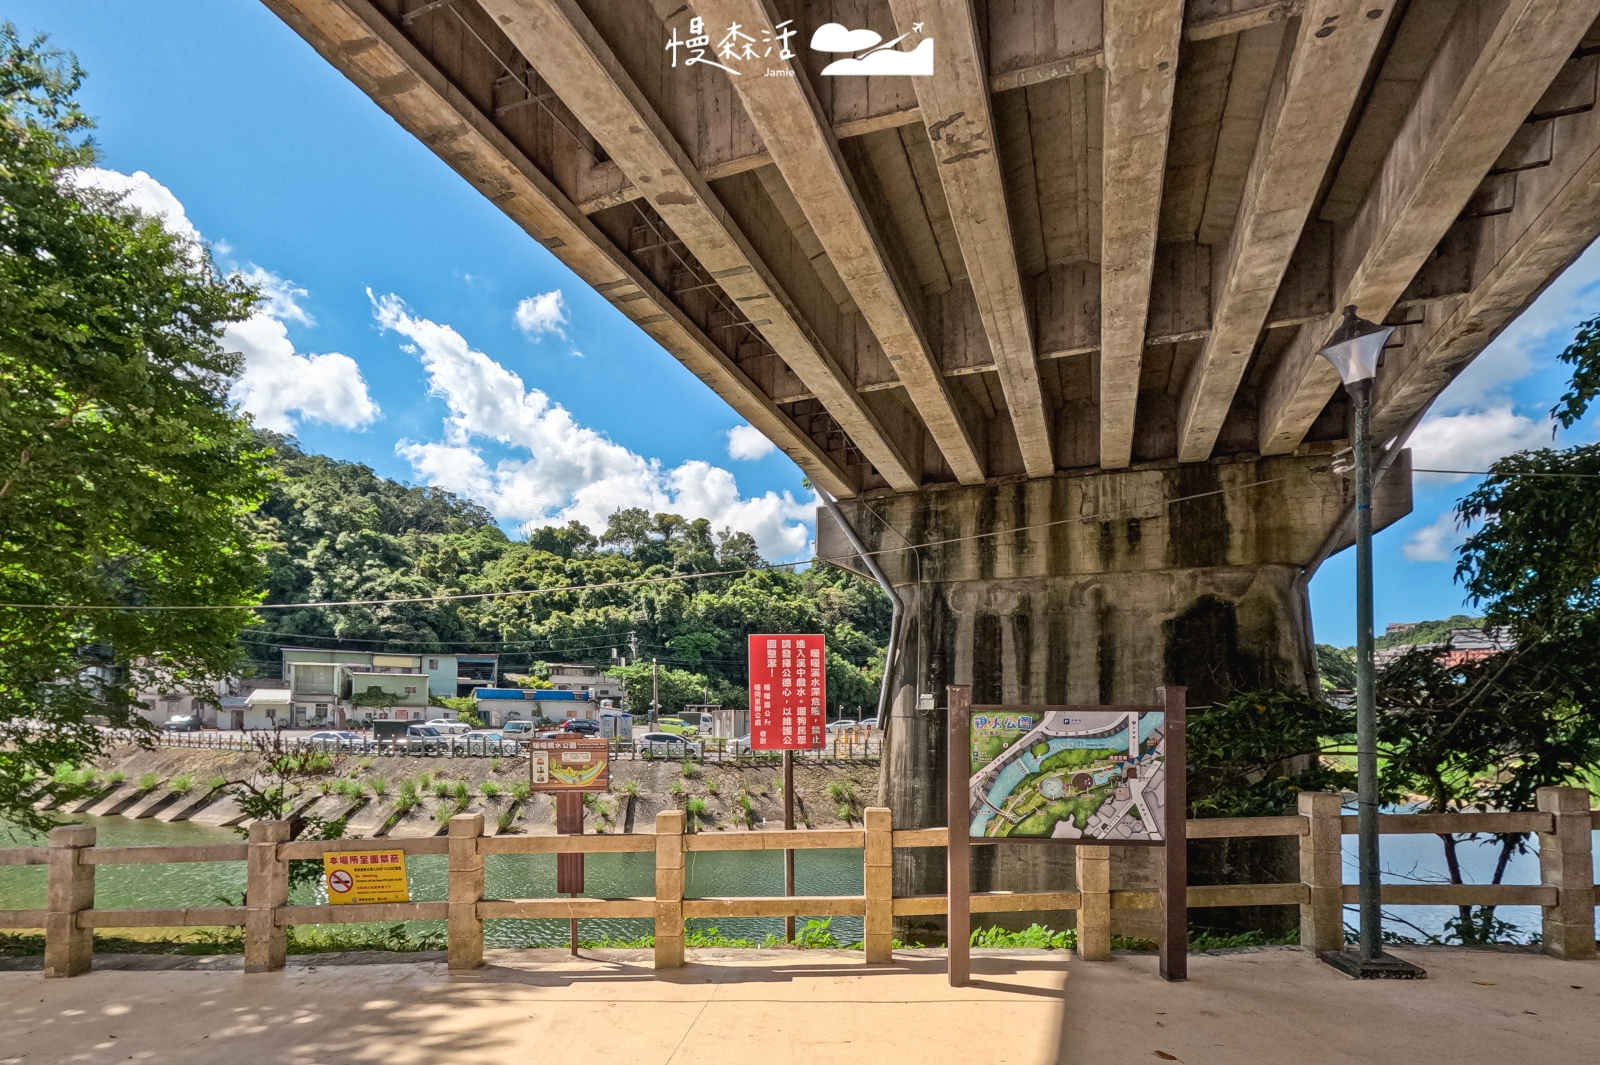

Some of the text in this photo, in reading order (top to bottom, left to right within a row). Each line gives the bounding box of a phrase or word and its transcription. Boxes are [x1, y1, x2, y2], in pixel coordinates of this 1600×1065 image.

[782, 640, 792, 744] 請發揮公德心，以維護公
[973, 716, 1032, 730] 親水公園
[330, 854, 399, 864] 本場所全面禁菸
